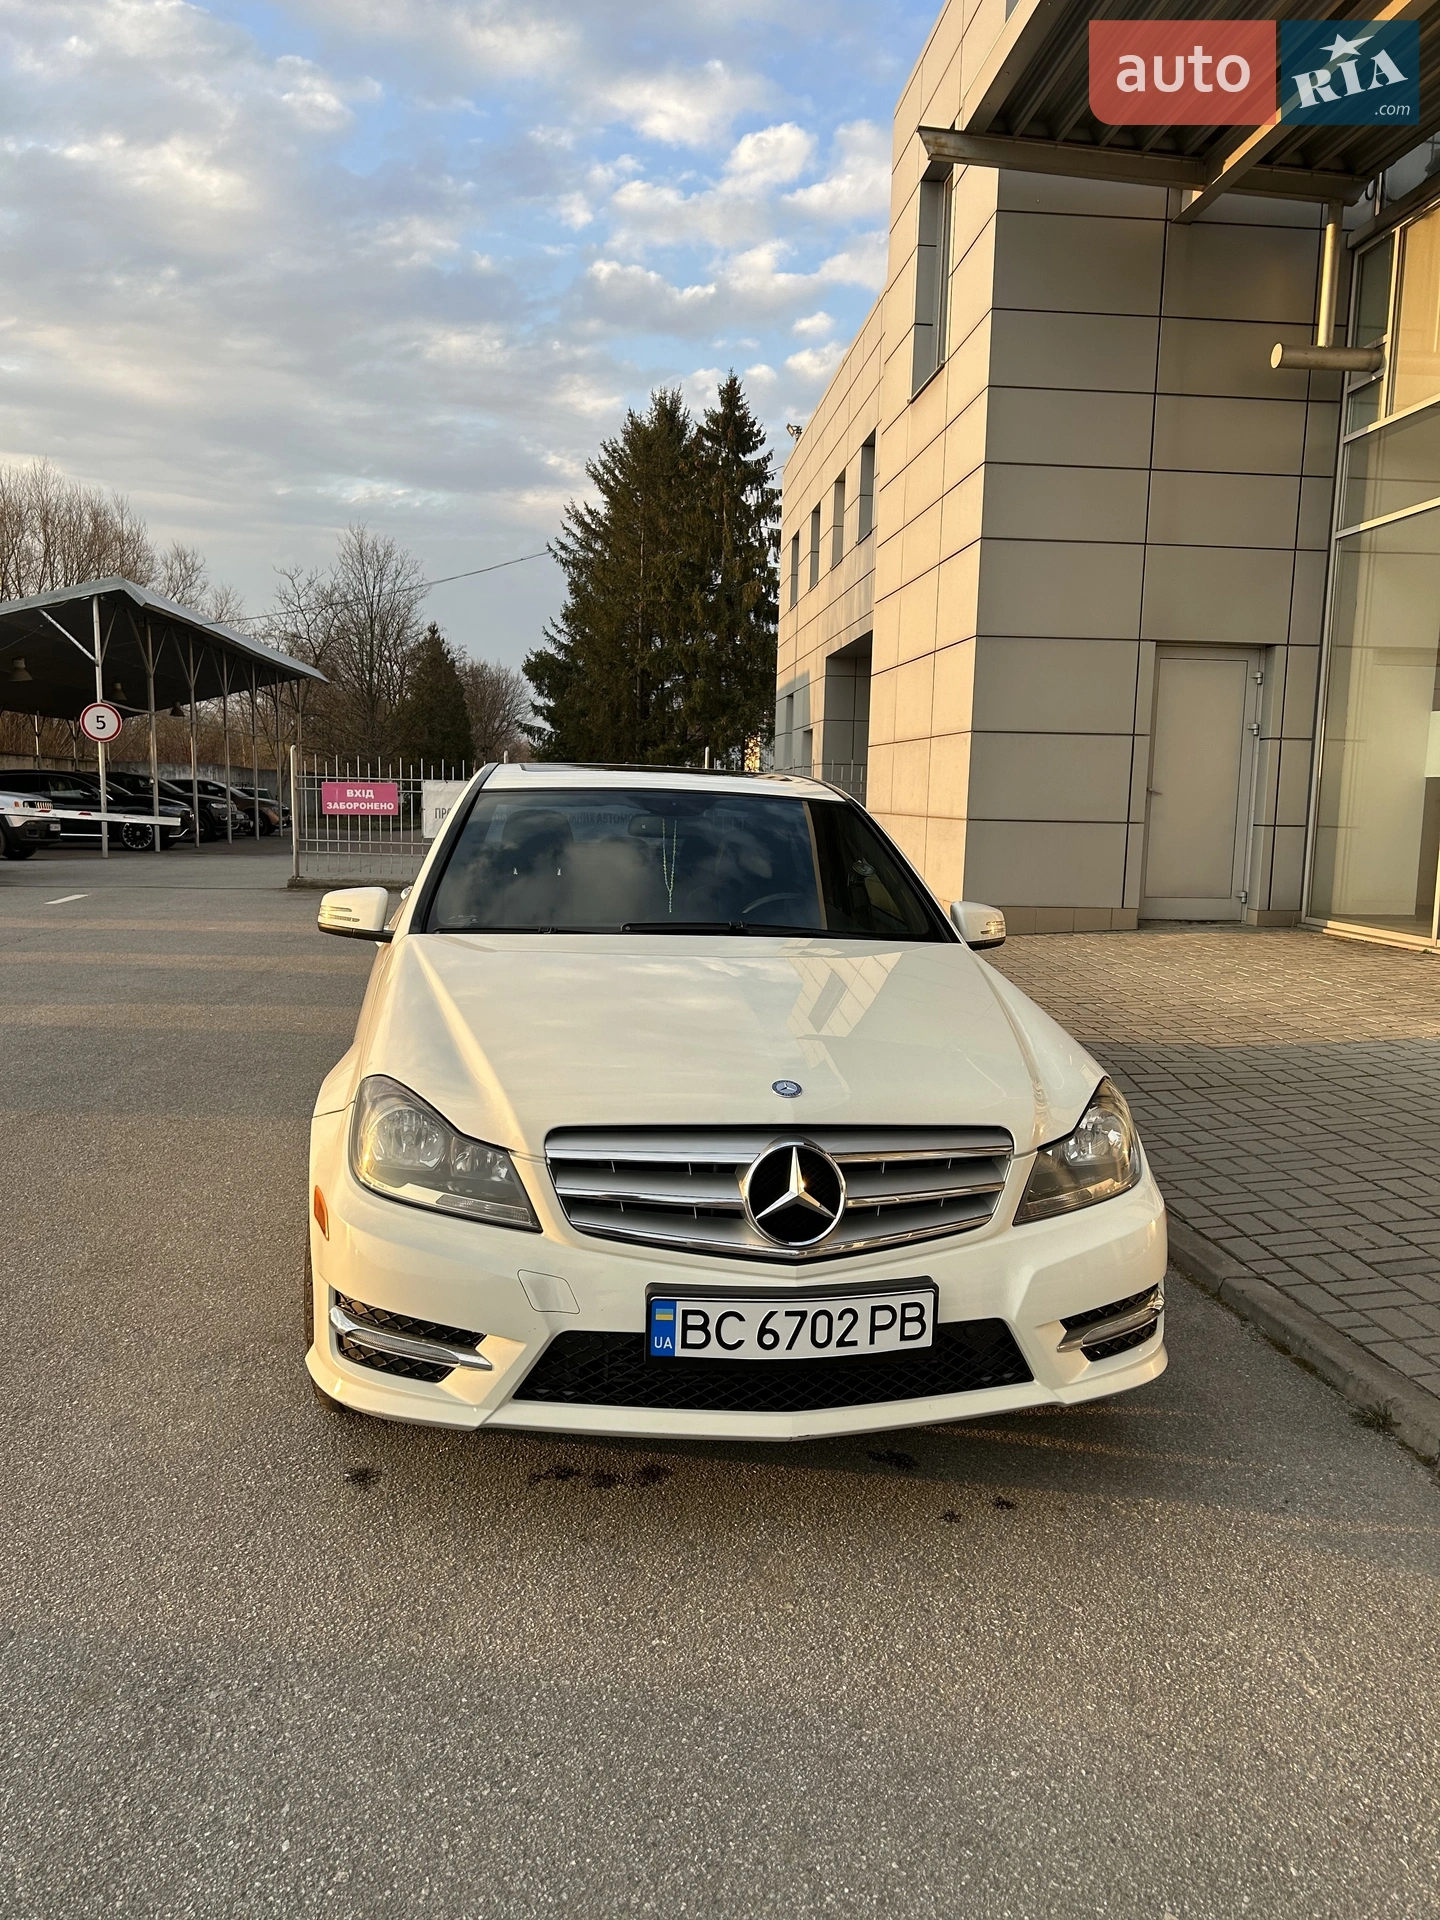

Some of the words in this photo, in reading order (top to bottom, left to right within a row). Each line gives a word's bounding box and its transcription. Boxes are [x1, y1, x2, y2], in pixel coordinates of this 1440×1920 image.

[95, 715, 107, 730] 5
[346, 789, 375, 799] ВХІД
[326, 801, 395, 810] ЗАБОРОНЕНО
[680, 1308, 747, 1351] BC
[756, 1307, 859, 1351] 6702
[869, 1301, 927, 1346] PB
[654, 1336, 673, 1349] UA
